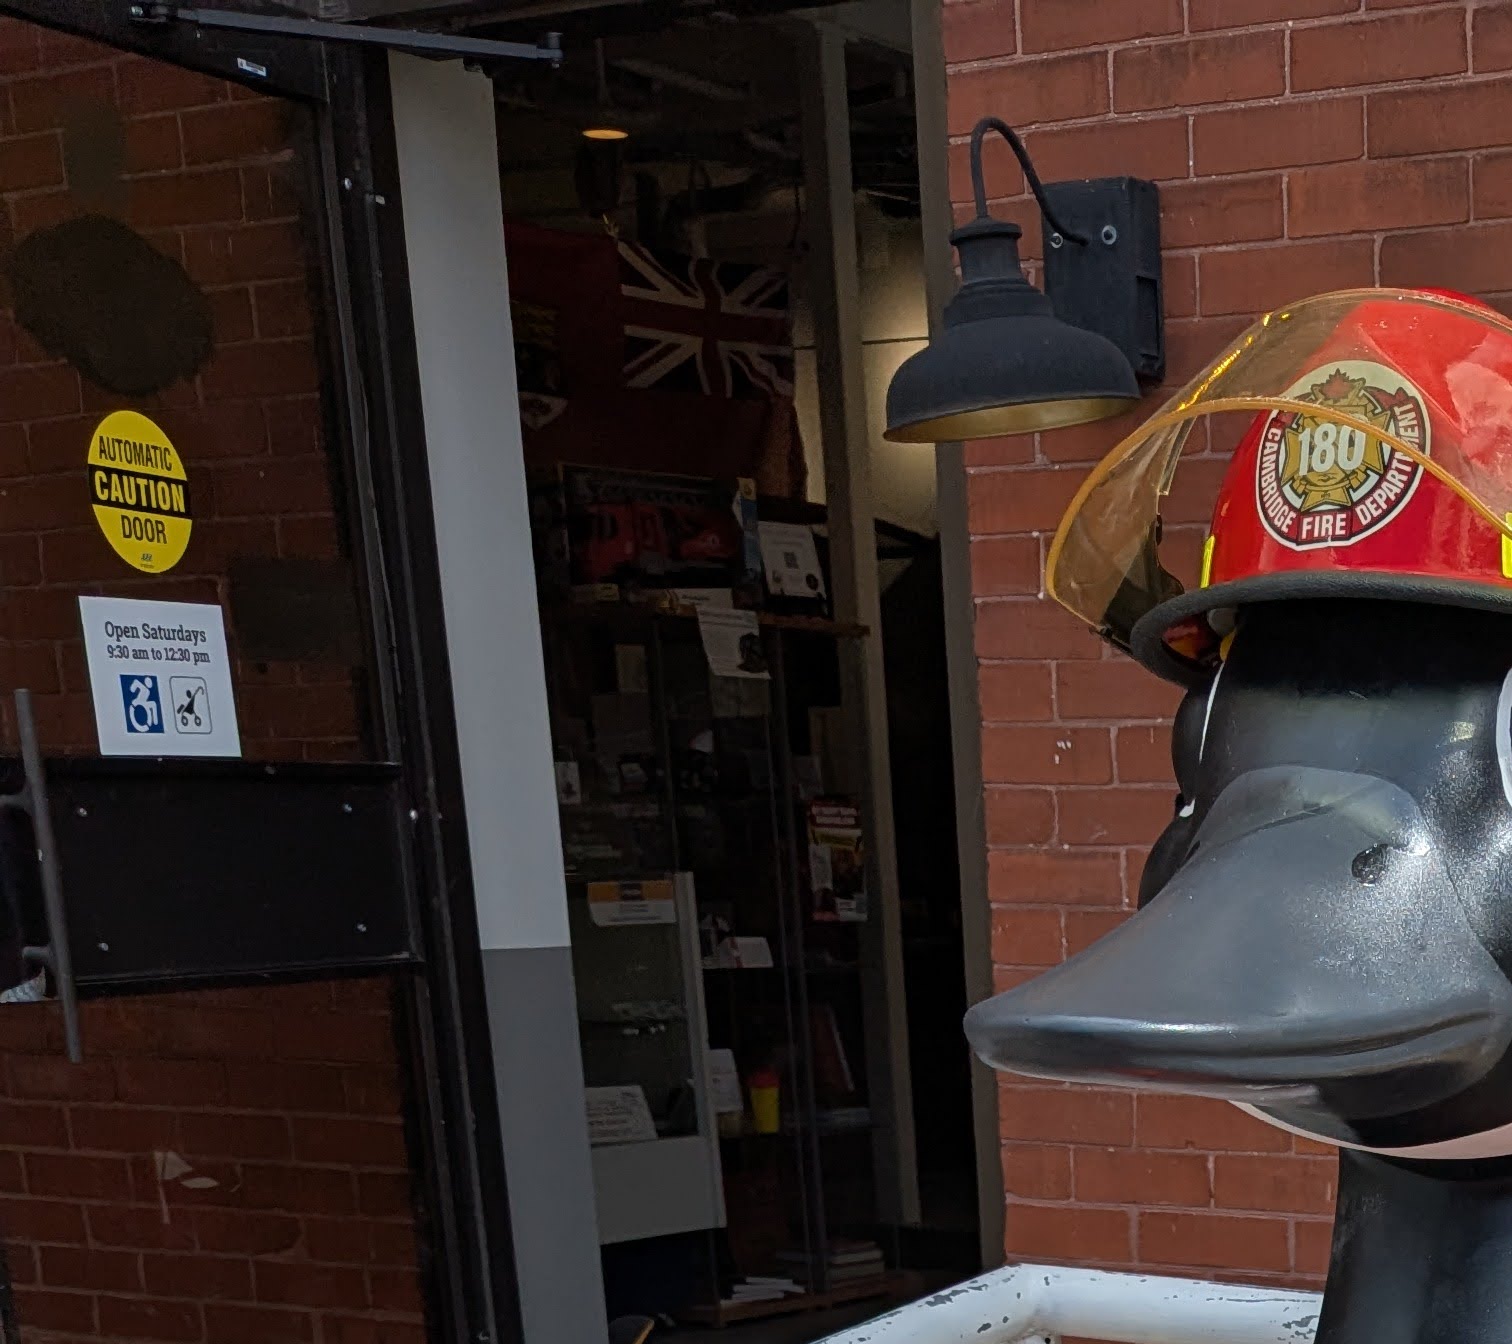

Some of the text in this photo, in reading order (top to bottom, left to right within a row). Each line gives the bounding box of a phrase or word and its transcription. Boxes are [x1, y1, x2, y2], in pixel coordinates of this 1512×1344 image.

[98, 435, 173, 472] AUTOMATIC
[1298, 422, 1366, 476] 180
[1261, 402, 1421, 541] CAMBRIDGE FIRE DEPARTMENT
[94, 470, 186, 513] CAUTION
[120, 514, 167, 545] DOOR
[104, 620, 207, 647] Open Saturdays
[106, 644, 211, 666] 9:30 am to 12:30 pm
